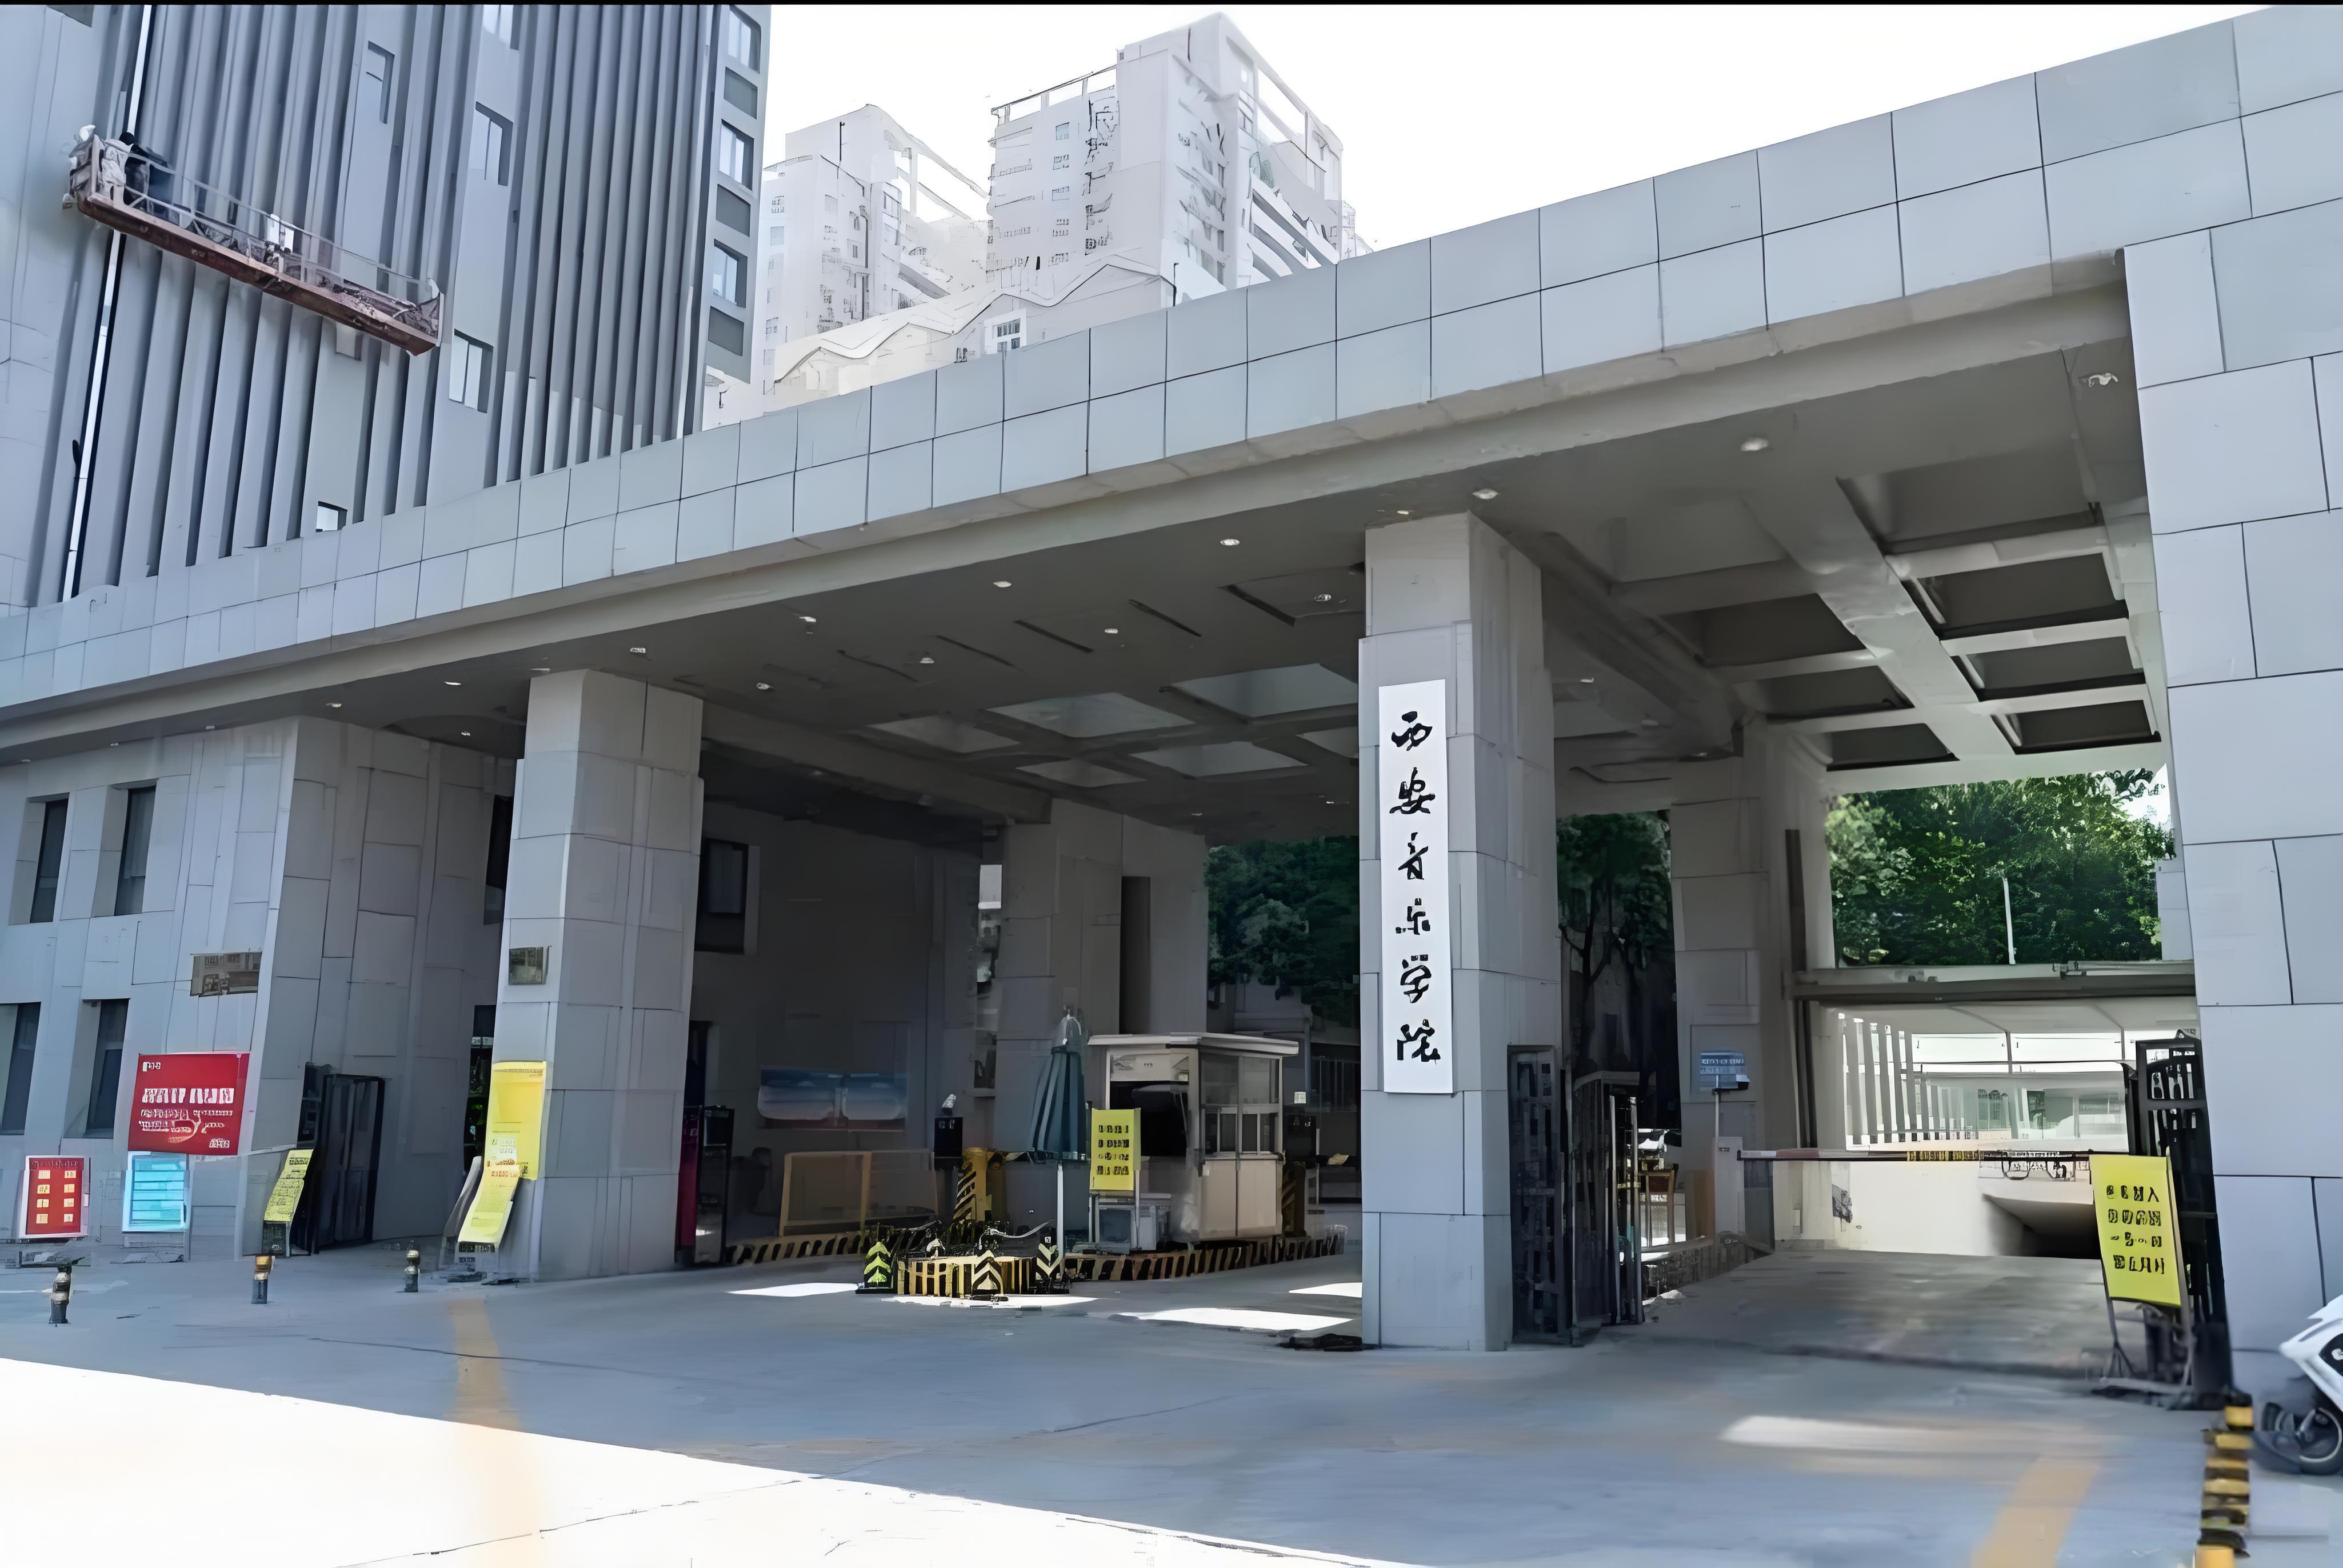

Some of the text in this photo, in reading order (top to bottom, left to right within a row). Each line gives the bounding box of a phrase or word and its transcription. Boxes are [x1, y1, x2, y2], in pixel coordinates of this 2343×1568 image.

[1389, 711, 1441, 1063] 西安音乐学院
